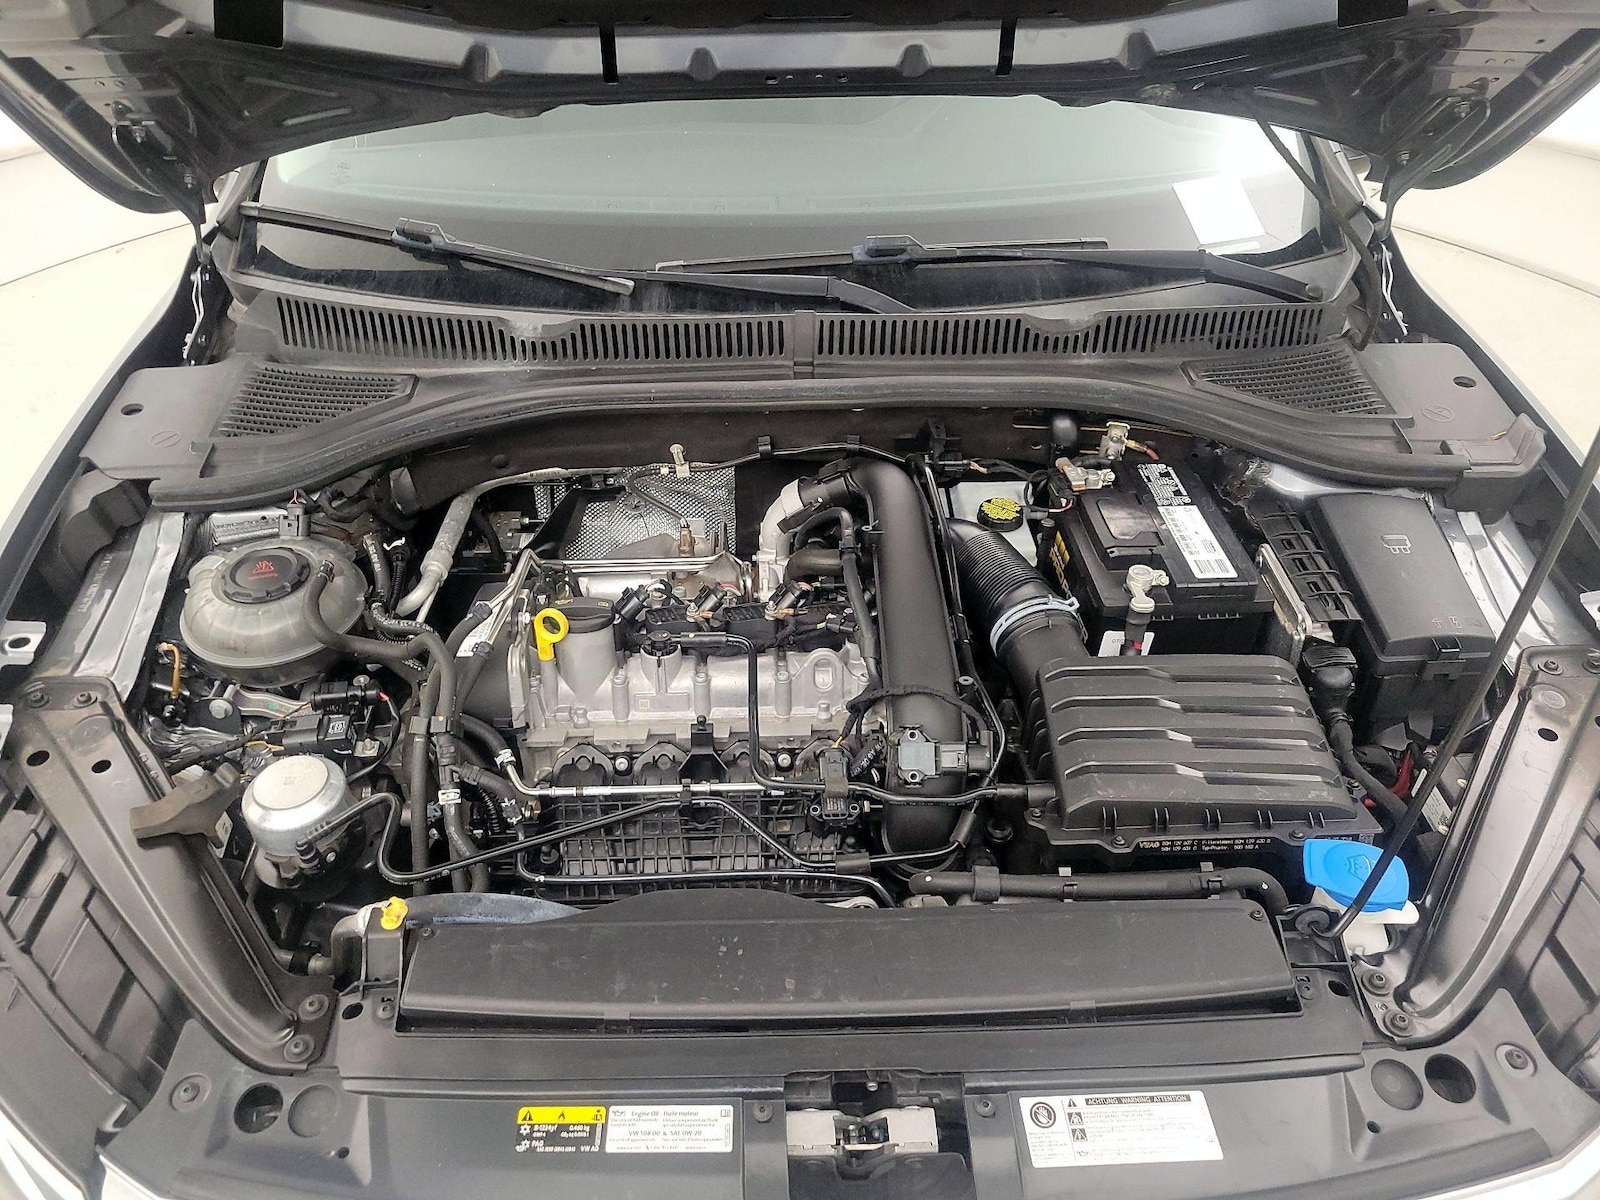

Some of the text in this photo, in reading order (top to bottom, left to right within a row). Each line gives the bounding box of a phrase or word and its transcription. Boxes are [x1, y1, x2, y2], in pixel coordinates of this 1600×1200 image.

[1088, 1095, 1187, 1105] ACHTUNG WARNING ATTENTION
[631, 1110, 650, 1118] Engine
